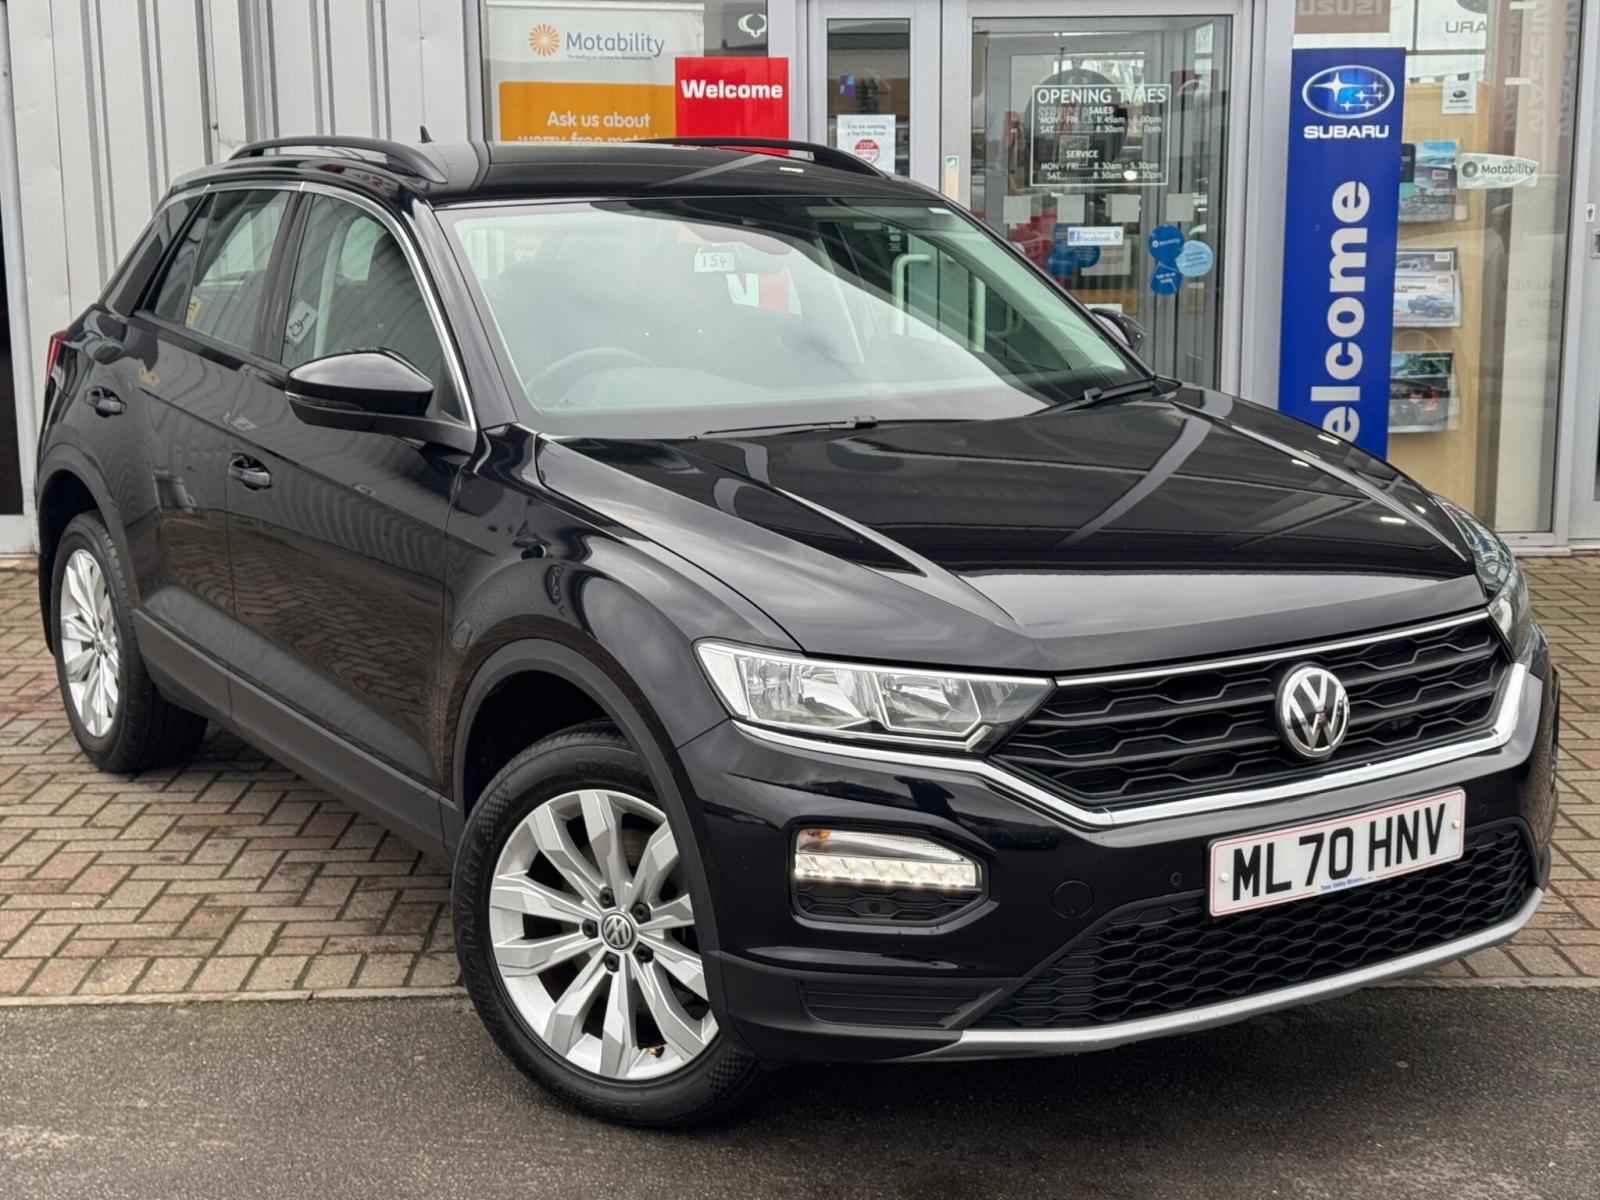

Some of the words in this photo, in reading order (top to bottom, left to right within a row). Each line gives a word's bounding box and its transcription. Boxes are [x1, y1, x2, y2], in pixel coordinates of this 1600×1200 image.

[566, 31, 665, 57] Motability
[680, 79, 784, 99] Welcome
[1037, 88, 1112, 104] OPENING
[1117, 88, 1167, 103] TIMES
[1089, 106, 1114, 114] SALES
[547, 111, 577, 127] Ask
[581, 115, 600, 127] us
[603, 112, 651, 128] about
[1303, 125, 1390, 140] SUBARU
[1066, 149, 1099, 159] SERVICE
[1481, 162, 1536, 176] Motability
[1233, 841, 1292, 901] ML
[1299, 826, 1354, 887] 70
[1368, 803, 1446, 872] HNV
